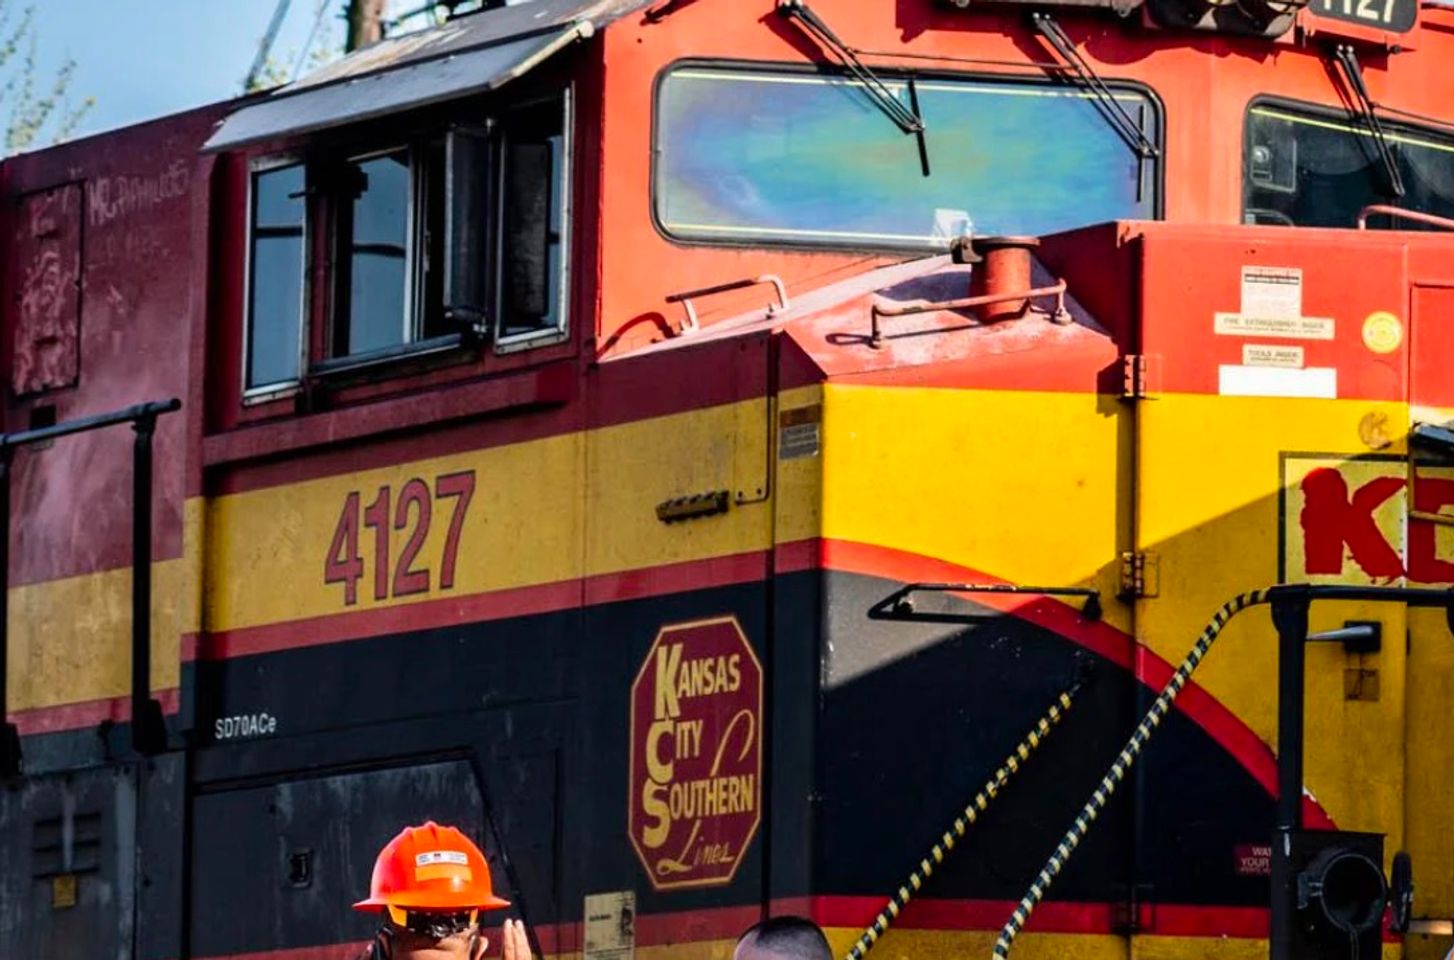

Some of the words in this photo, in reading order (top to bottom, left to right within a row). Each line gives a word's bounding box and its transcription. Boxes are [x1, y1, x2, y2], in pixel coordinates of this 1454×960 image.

[325, 469, 476, 606] 4127
[654, 643, 741, 720] KANSAS
[214, 712, 277, 740] SD70ACe
[645, 716, 704, 784] CITY
[642, 774, 755, 848] SOUTHERN
